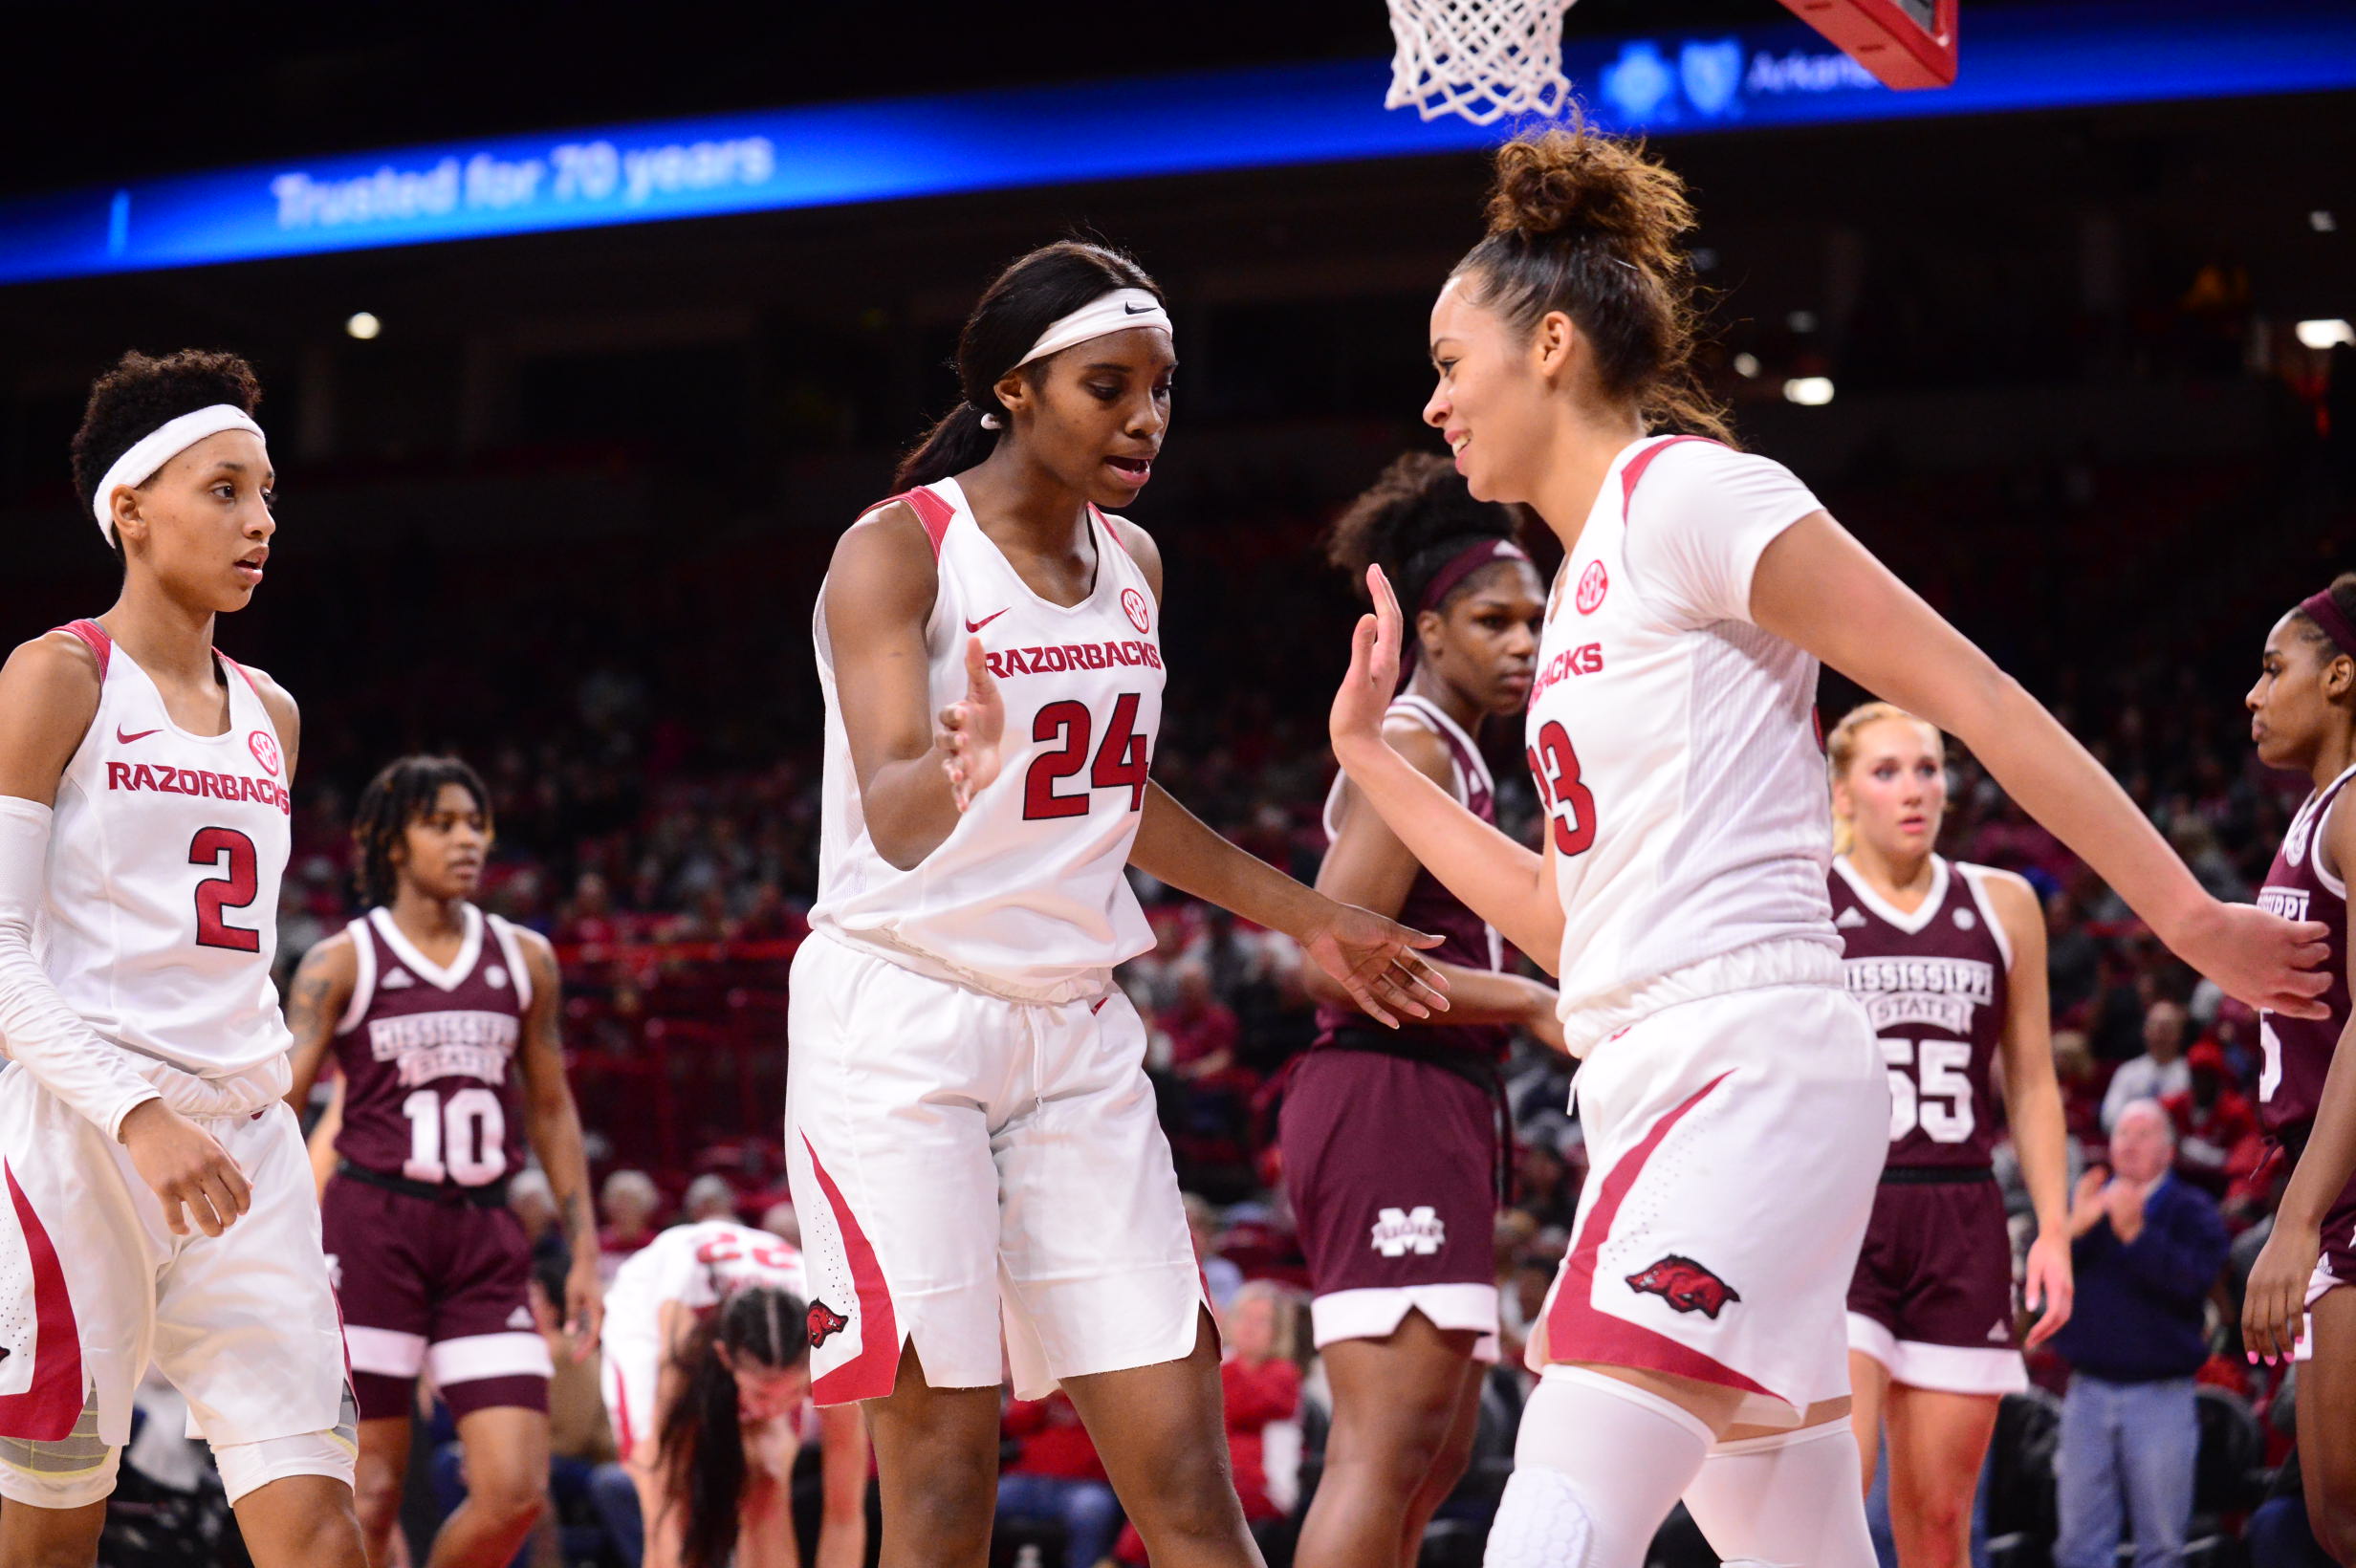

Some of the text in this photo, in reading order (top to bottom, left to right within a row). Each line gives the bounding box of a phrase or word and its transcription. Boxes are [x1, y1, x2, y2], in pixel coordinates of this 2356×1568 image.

[272, 137, 773, 228] Trusted for 70 years
[985, 641, 1162, 679] RAZORBACKS
[105, 761, 290, 816] RAZORBACKS
[1022, 693, 1148, 821] 24
[188, 826, 260, 953] 2
[1843, 961, 1993, 999] ISSISSIPPI
[1875, 997, 1957, 1022] STATE
[403, 1087, 507, 1187] 10
